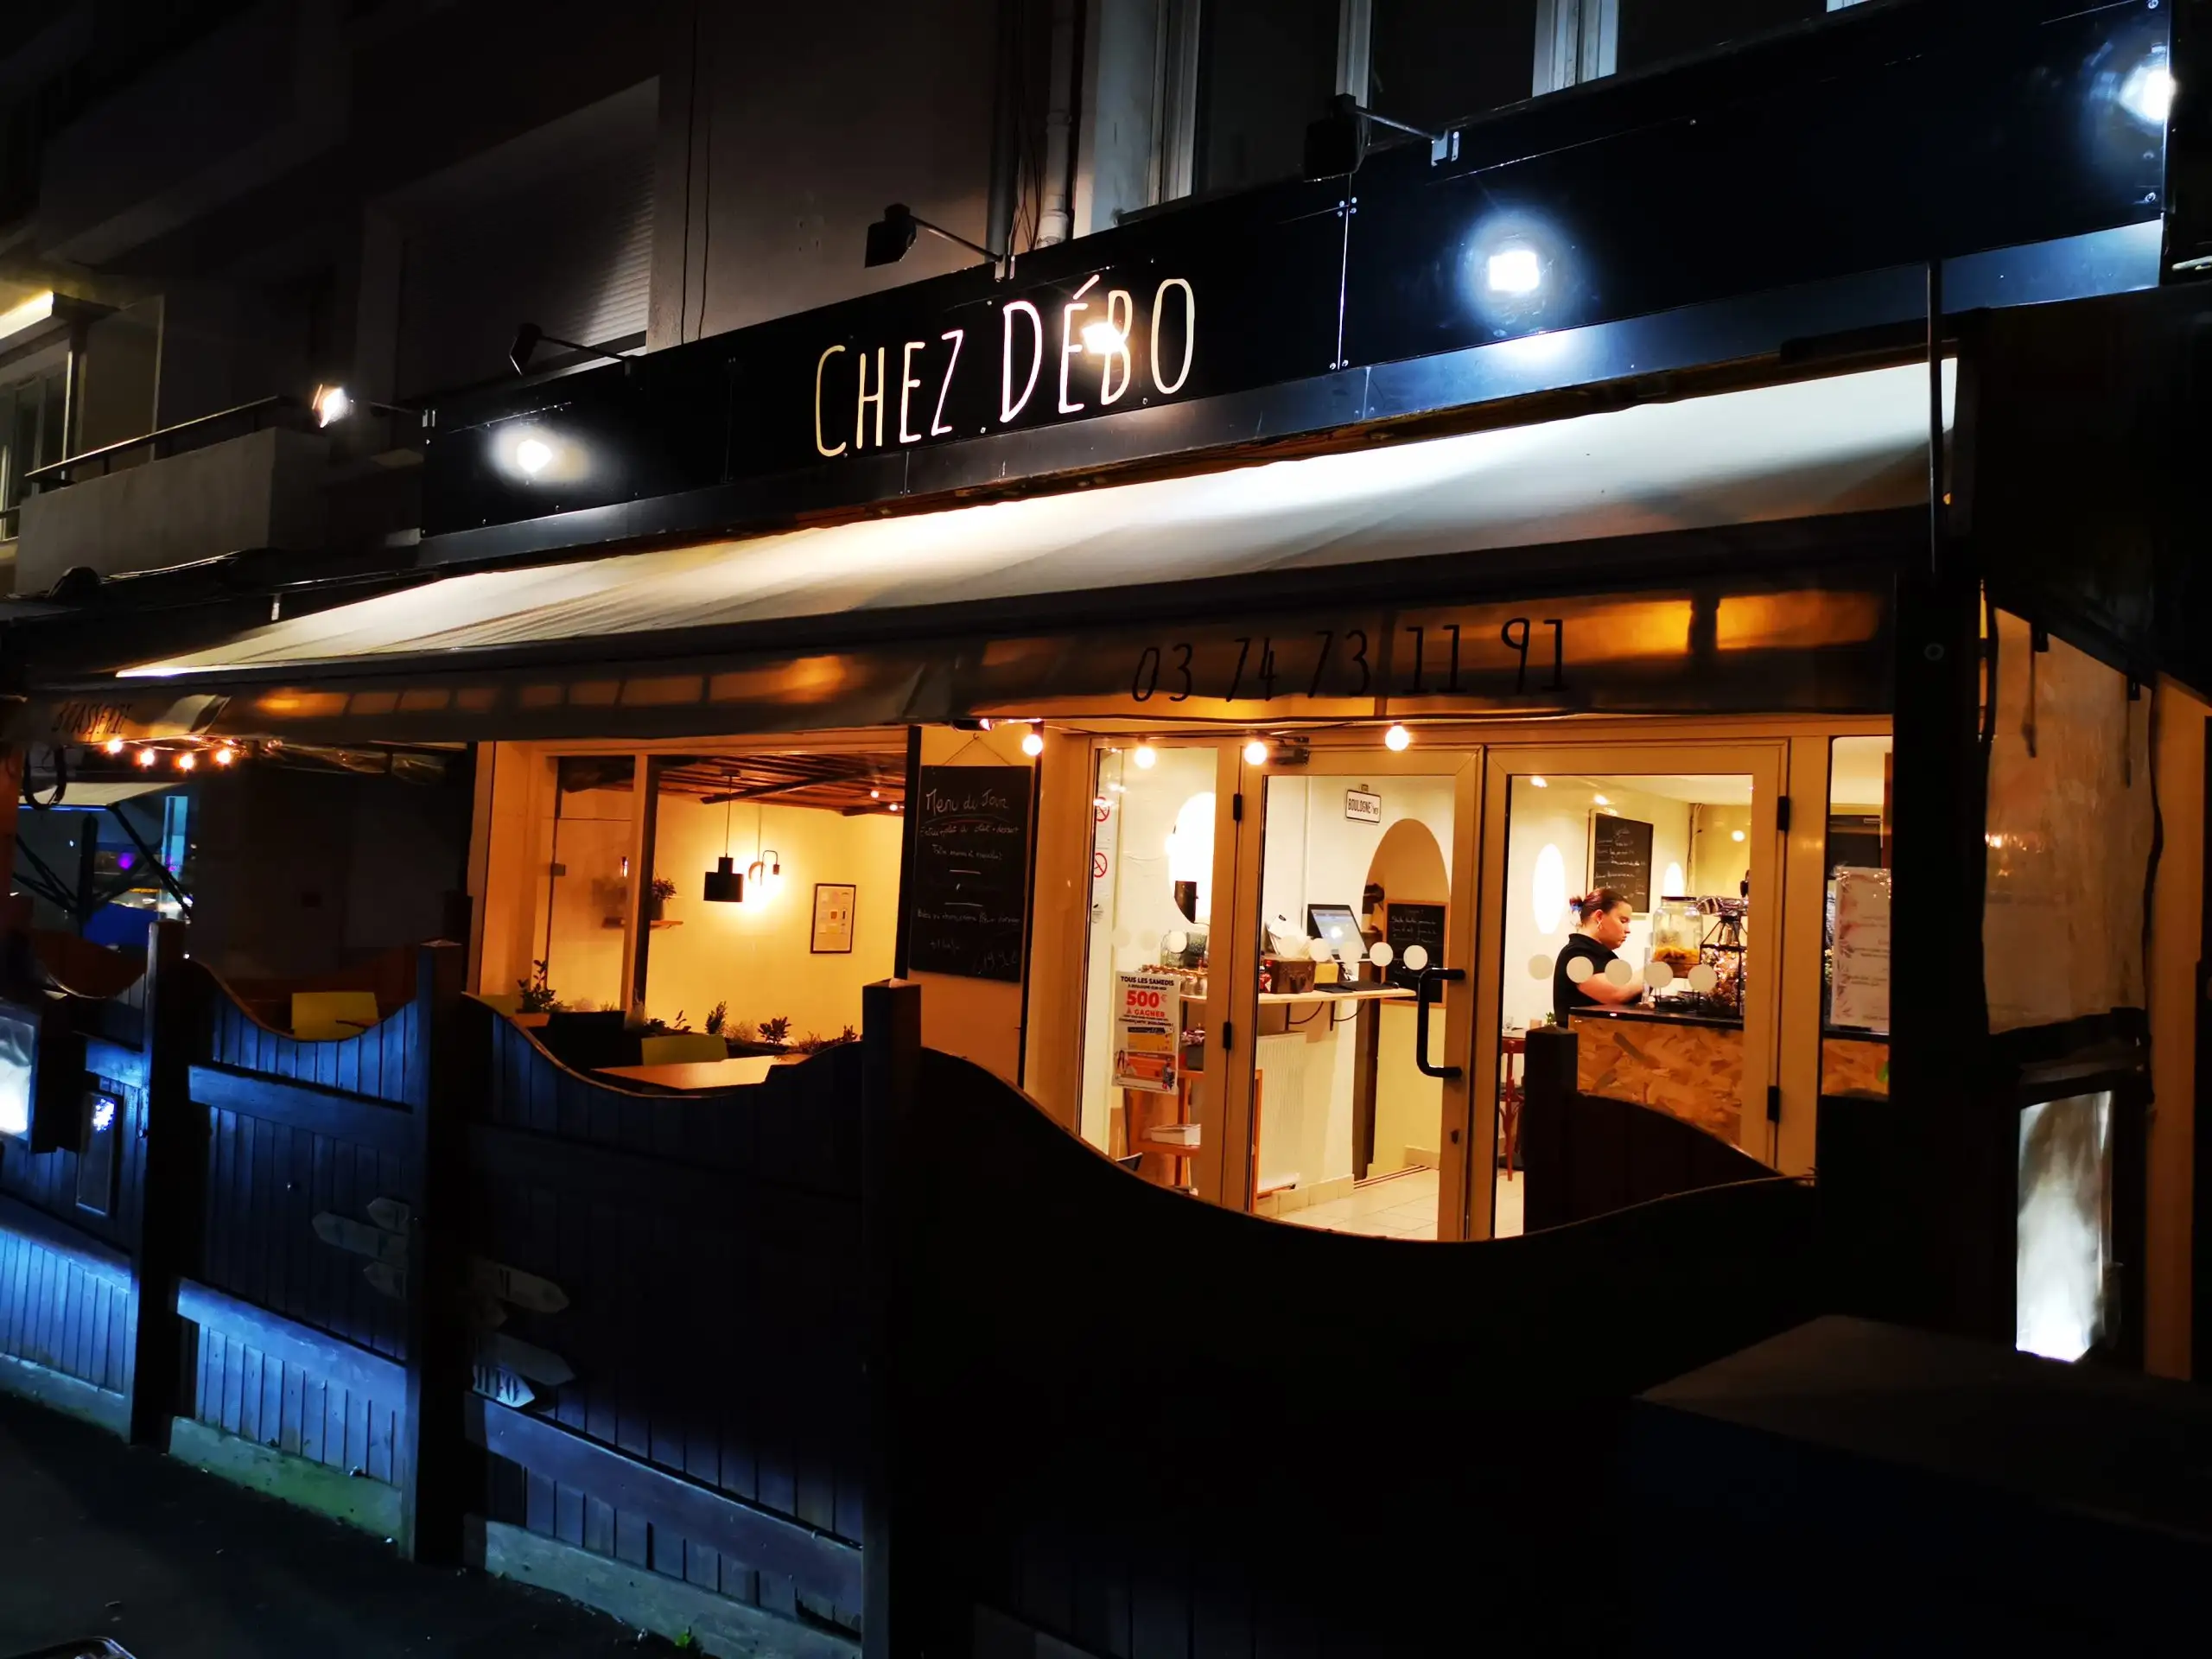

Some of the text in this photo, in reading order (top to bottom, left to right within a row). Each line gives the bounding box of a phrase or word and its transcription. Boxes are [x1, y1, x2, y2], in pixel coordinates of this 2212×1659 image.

[816, 273, 1195, 456] CHEZ DÉBO
[1130, 618, 1572, 702] 03 74 73 11 91
[925, 787, 959, 817] Menu
[1348, 798, 1370, 813] BOULOGNE
[1127, 990, 1160, 1008] 500
[1135, 1009, 1165, 1018] GAGNER
